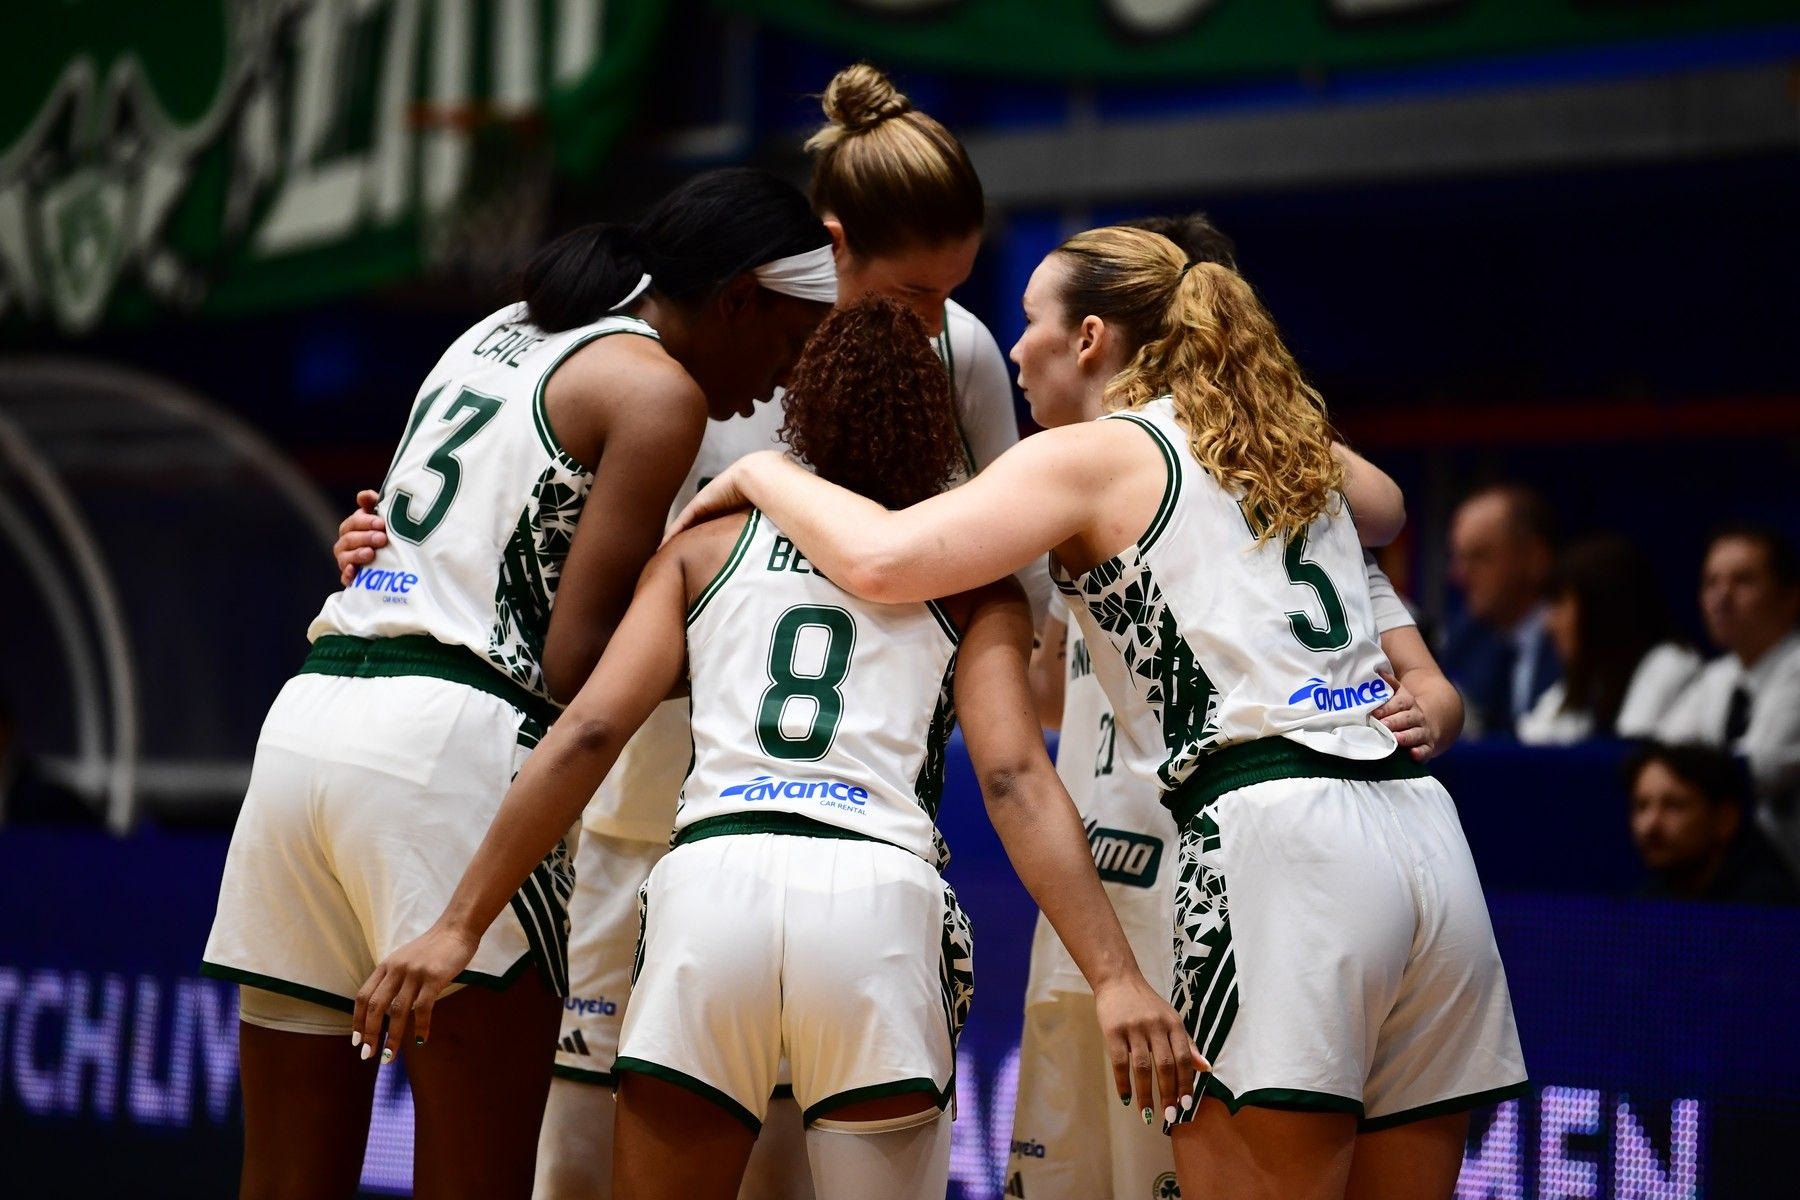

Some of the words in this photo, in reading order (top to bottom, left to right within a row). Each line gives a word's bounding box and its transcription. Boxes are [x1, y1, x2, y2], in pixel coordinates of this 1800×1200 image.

[377, 379, 507, 547] 13
[766, 535, 830, 581] BE
[755, 603, 857, 763] 8
[1313, 679, 1388, 711] avance
[743, 779, 868, 806] avance
[820, 800, 835, 808] CAR
[837, 803, 867, 815] RENTAL
